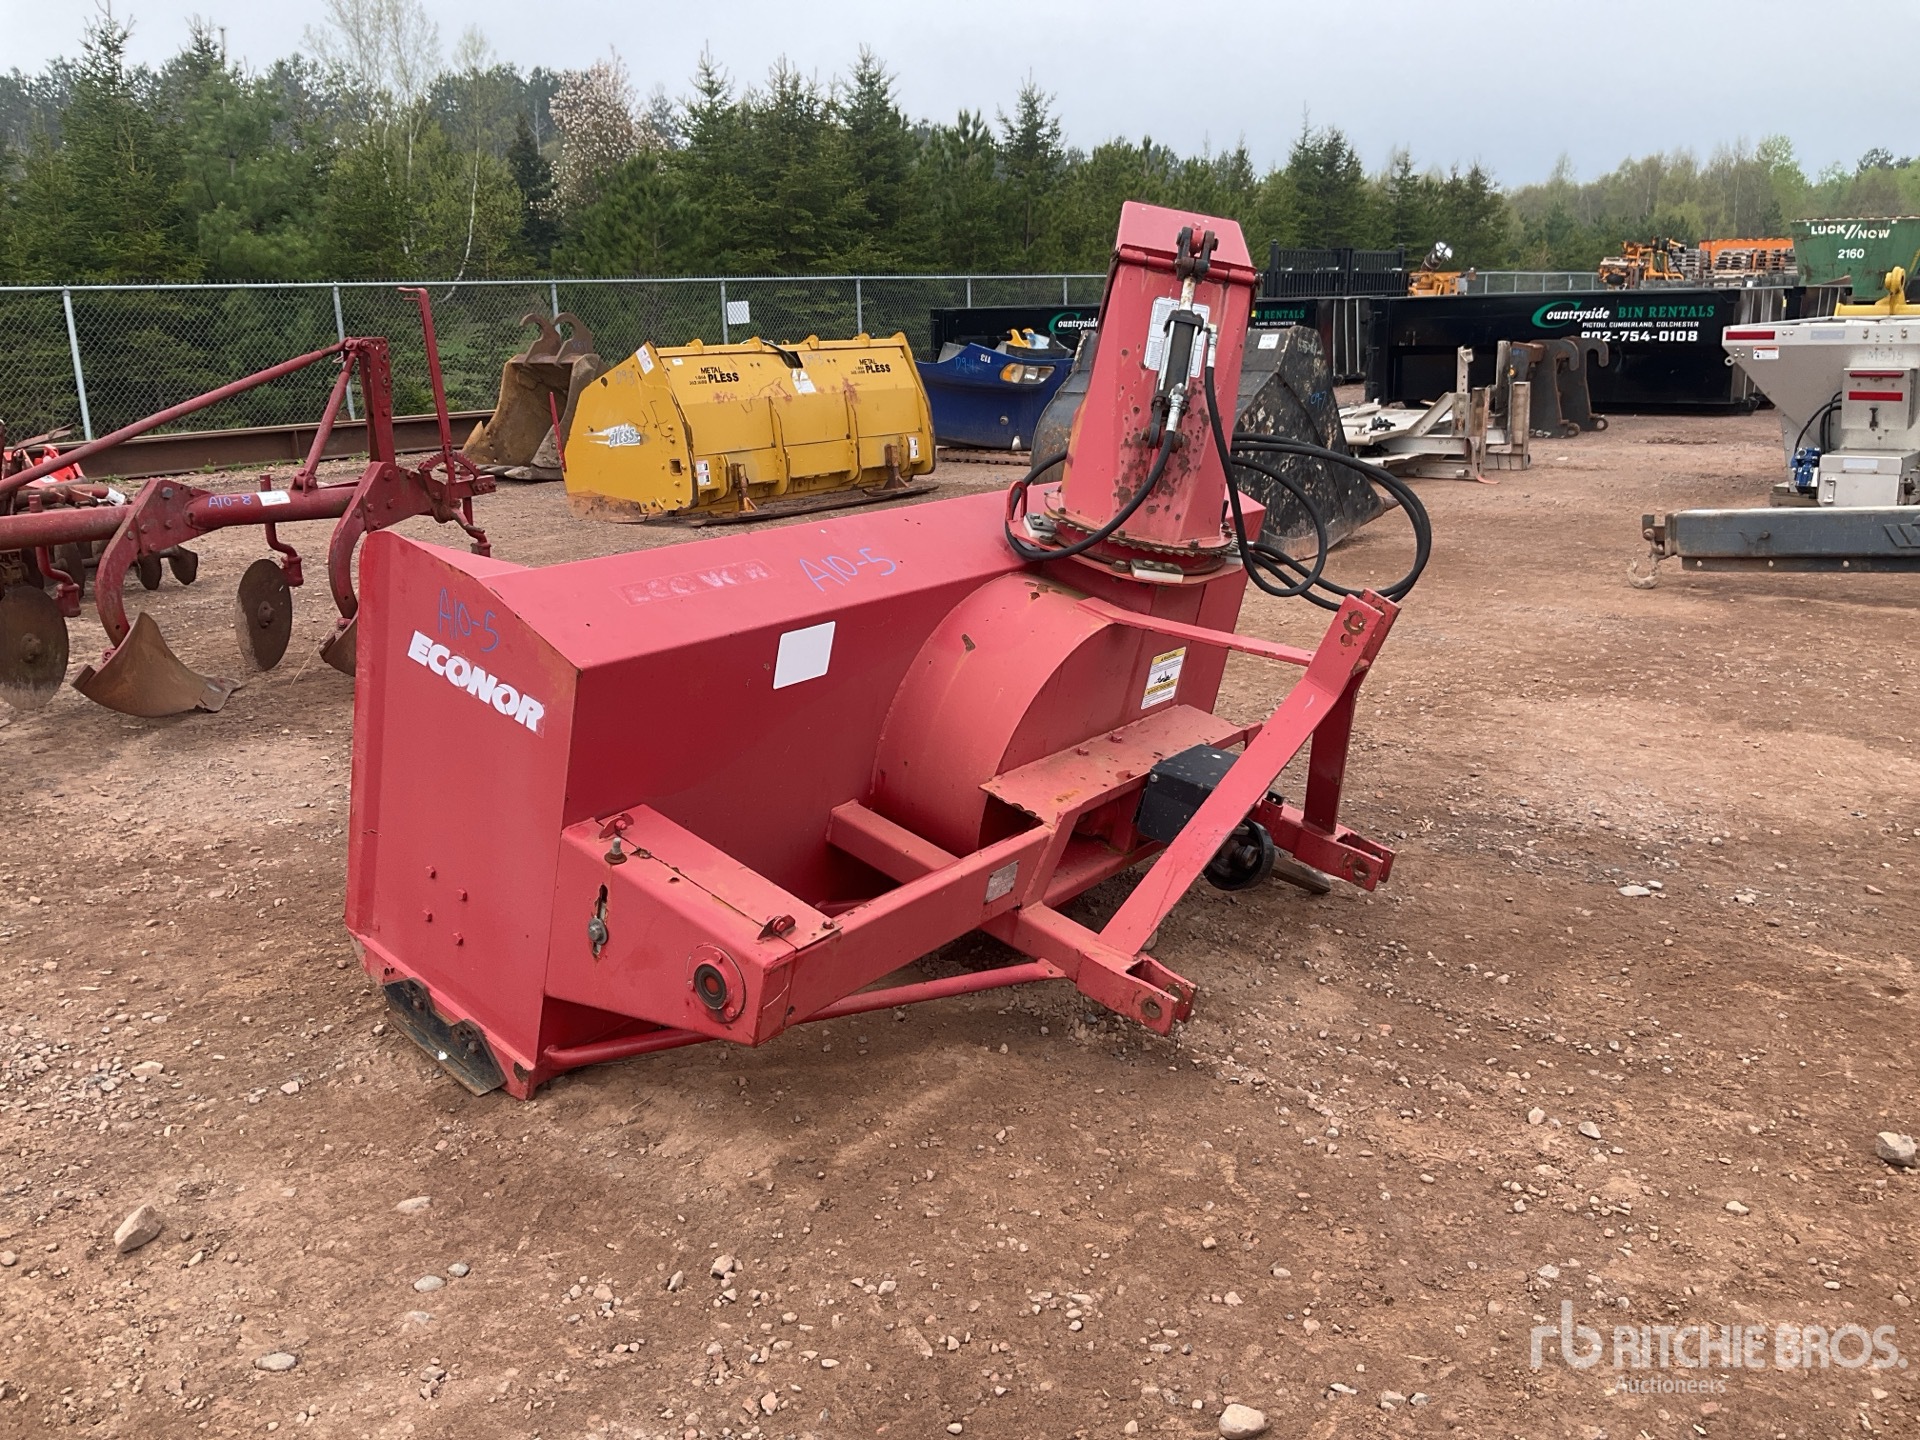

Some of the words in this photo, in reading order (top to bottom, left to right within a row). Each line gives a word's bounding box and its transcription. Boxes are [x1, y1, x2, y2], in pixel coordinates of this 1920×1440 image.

[1837, 248, 1865, 259] 2160
[1264, 309, 1305, 319] RENTALS
[1531, 300, 1610, 329] Countryside
[1618, 306, 1644, 318] BIN
[1648, 305, 1715, 318] RENTALS
[859, 358, 878, 366] METAL
[700, 366, 722, 374] METAL
[865, 364, 891, 374] PLESS
[708, 372, 740, 384] PLESS
[609, 429, 635, 446] PLESS
[208, 494, 252, 508] A10-8
[800, 548, 897, 592] A10-5
[437, 587, 500, 653] A10-5
[407, 630, 546, 733] ECONOR
